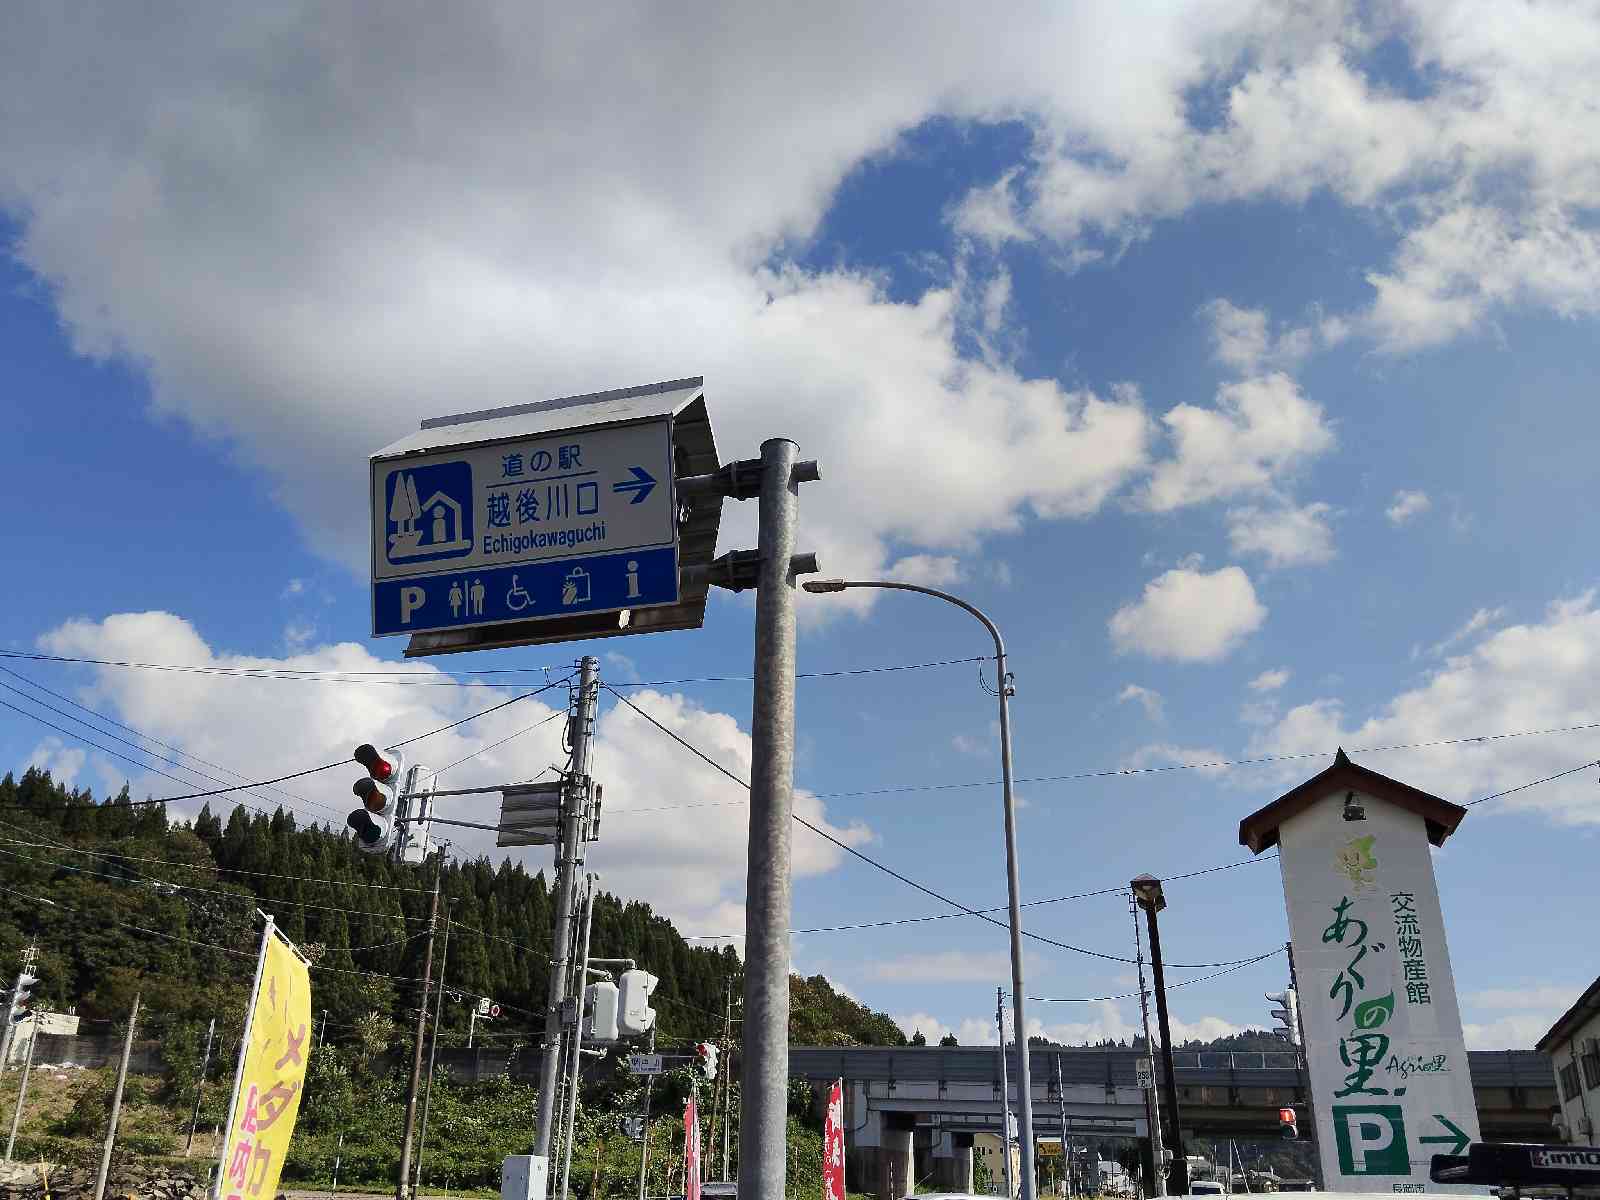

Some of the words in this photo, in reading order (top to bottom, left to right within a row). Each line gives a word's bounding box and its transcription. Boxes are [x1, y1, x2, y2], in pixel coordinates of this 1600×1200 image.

[502, 445, 582, 478] 道の駅
[487, 482, 599, 529] 越後川口
[483, 520, 606, 554] Echigokawaguchi
[400, 587, 426, 624] P
[1390, 891, 1431, 1005] 交流物産館
[1322, 896, 1393, 1098] あぐりの里
[1344, 1114, 1394, 1172] P
